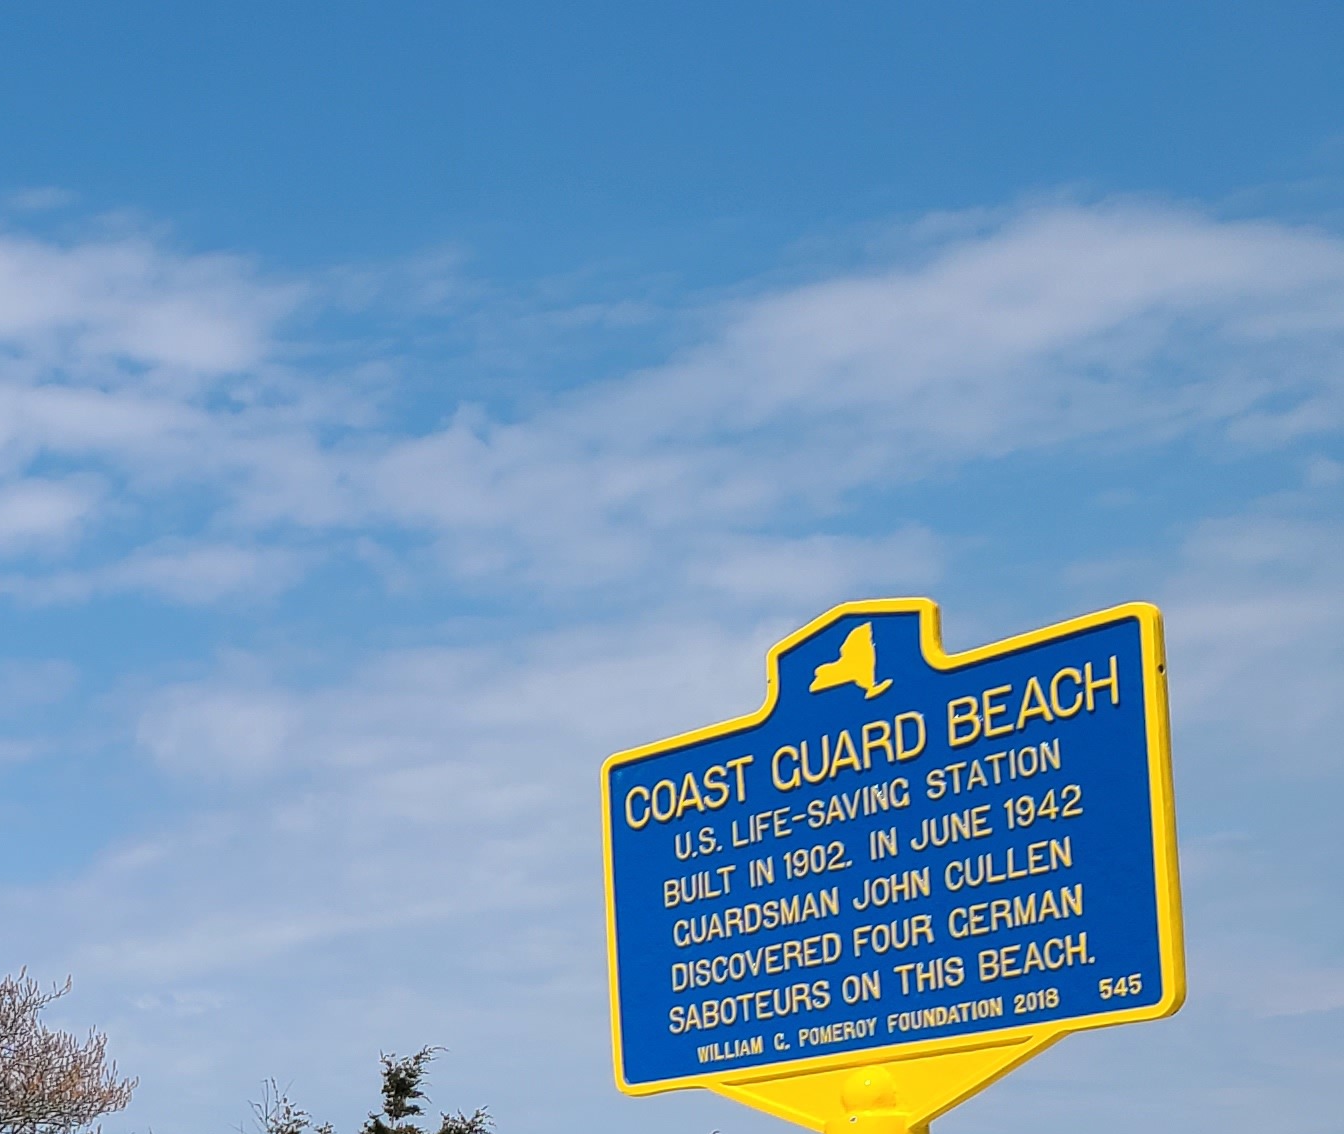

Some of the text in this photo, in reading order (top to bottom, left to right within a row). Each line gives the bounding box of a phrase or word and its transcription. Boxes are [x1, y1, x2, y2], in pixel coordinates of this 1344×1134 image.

[625, 655, 1119, 829] COAST GUARD BEACH
[663, 784, 1083, 908] BUILT IN 1902. IN JUNE 1942
[675, 738, 1061, 860] U.S. LIFE-SAVING STATION
[671, 883, 1083, 992] DISCOVERED FOUR GERMAN
[673, 836, 1072, 947] GUARDSMAN JOHN CULLEN
[669, 931, 1096, 1034] SABOTEURS ON THIS BEACH.
[697, 1035, 764, 1064] WILLIAM
[798, 1017, 877, 1047] POMEROY
[887, 996, 1003, 1034] FOUNDATION
[1013, 987, 1060, 1014] 2018
[1098, 973, 1143, 1000] 545
